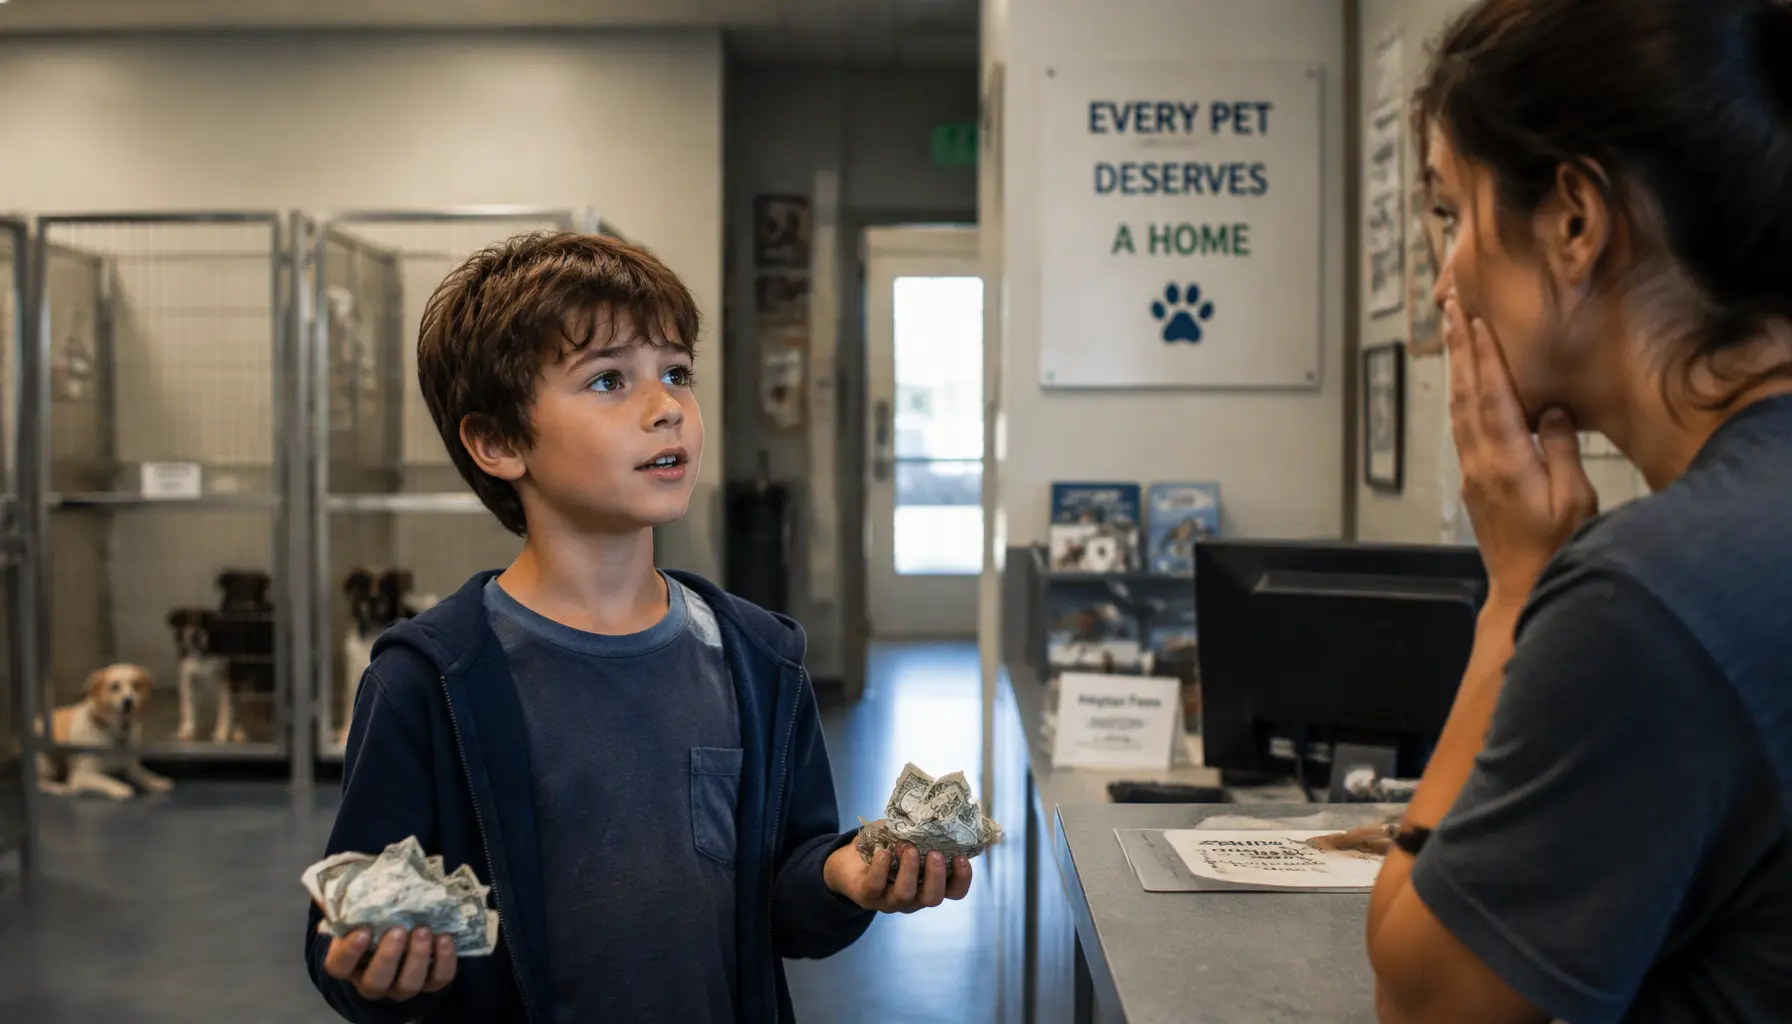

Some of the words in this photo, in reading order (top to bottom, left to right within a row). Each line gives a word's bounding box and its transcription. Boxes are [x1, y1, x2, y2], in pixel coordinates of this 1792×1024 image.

[1088, 101, 1199, 133] EVERY
[1210, 101, 1273, 134] PET
[1095, 163, 1268, 195] DESERVES
[1111, 223, 1136, 255] A
[1149, 223, 1251, 255] HOME
